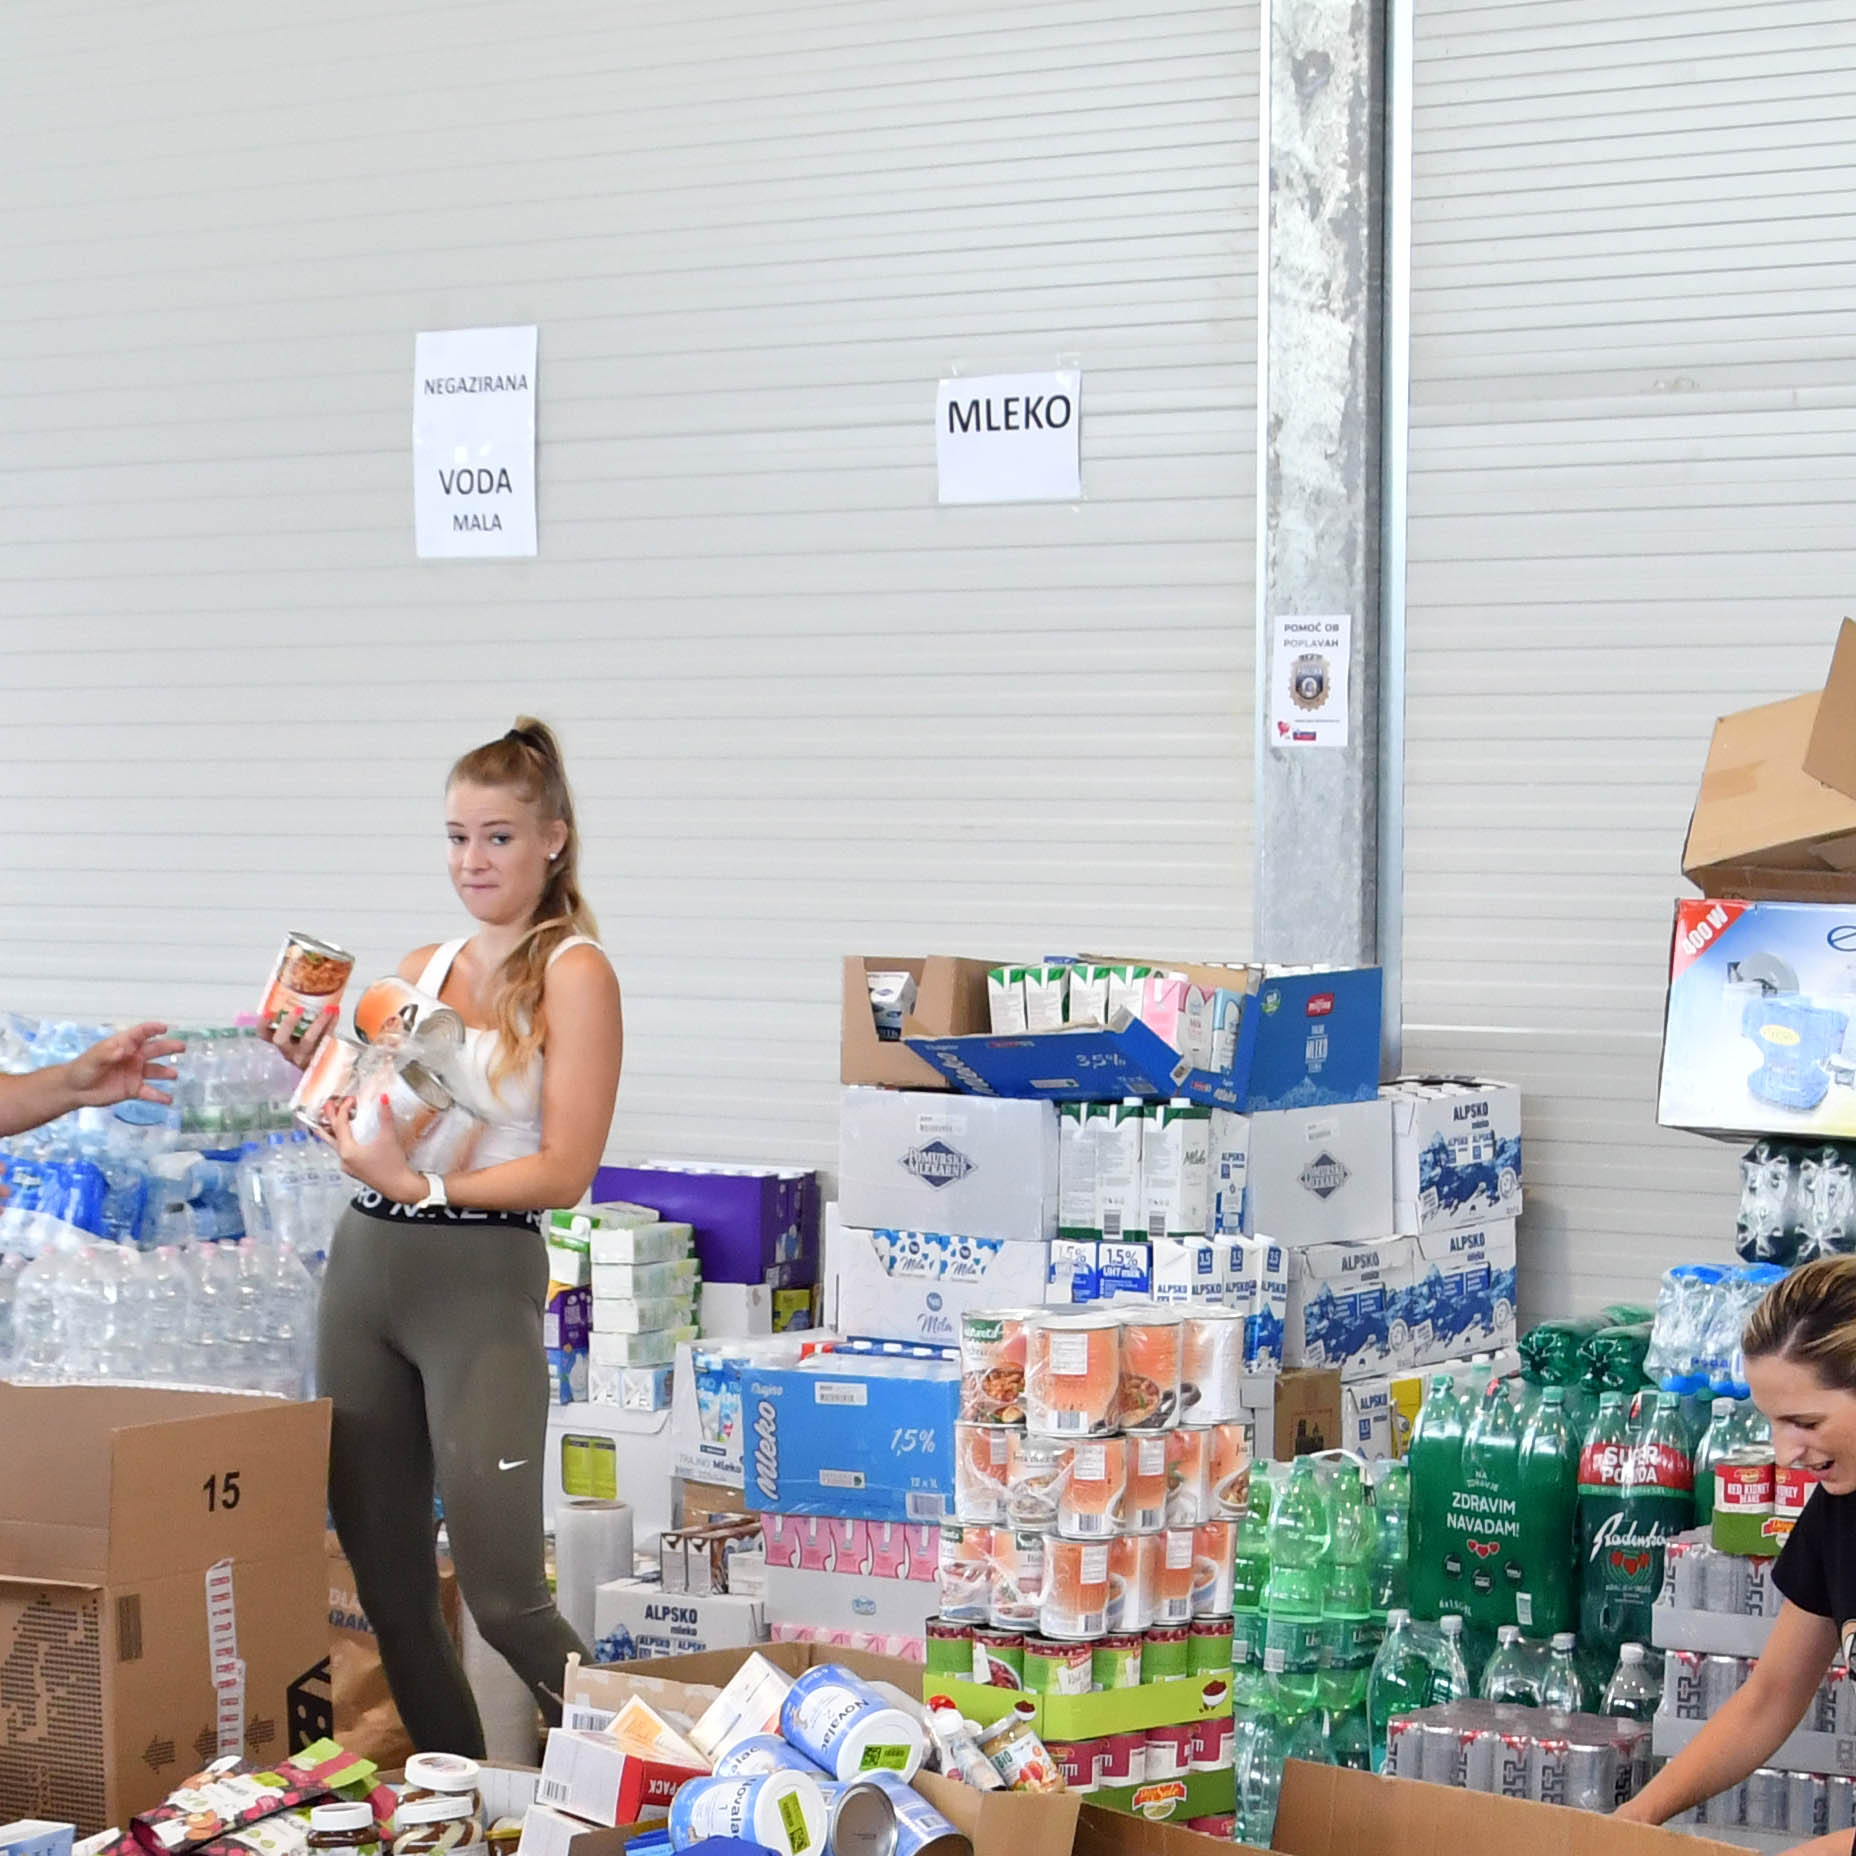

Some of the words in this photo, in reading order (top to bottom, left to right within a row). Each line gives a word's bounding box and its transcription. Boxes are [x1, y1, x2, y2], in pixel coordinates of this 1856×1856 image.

[424, 373, 529, 396] NEGAZIRANA
[946, 393, 1073, 437] MLEKO
[438, 467, 513, 496] VODA
[452, 513, 503, 532] MALA
[1681, 919, 1714, 957] 400
[1707, 905, 1730, 928] W
[1453, 1101, 1489, 1121] ALPSKO
[1449, 1231, 1486, 1253] ALPSKO
[1341, 1251, 1380, 1273] ALPSKO
[752, 1400, 779, 1501] Mleko
[201, 1470, 242, 1513] 15
[1452, 1492, 1517, 1516] ZDRAVIM
[1446, 1513, 1521, 1538] NAVADAM!
[644, 1603, 699, 1626] ALPSKO
[819, 1697, 870, 1754] Novalac
[648, 1779, 677, 1796] PACK
